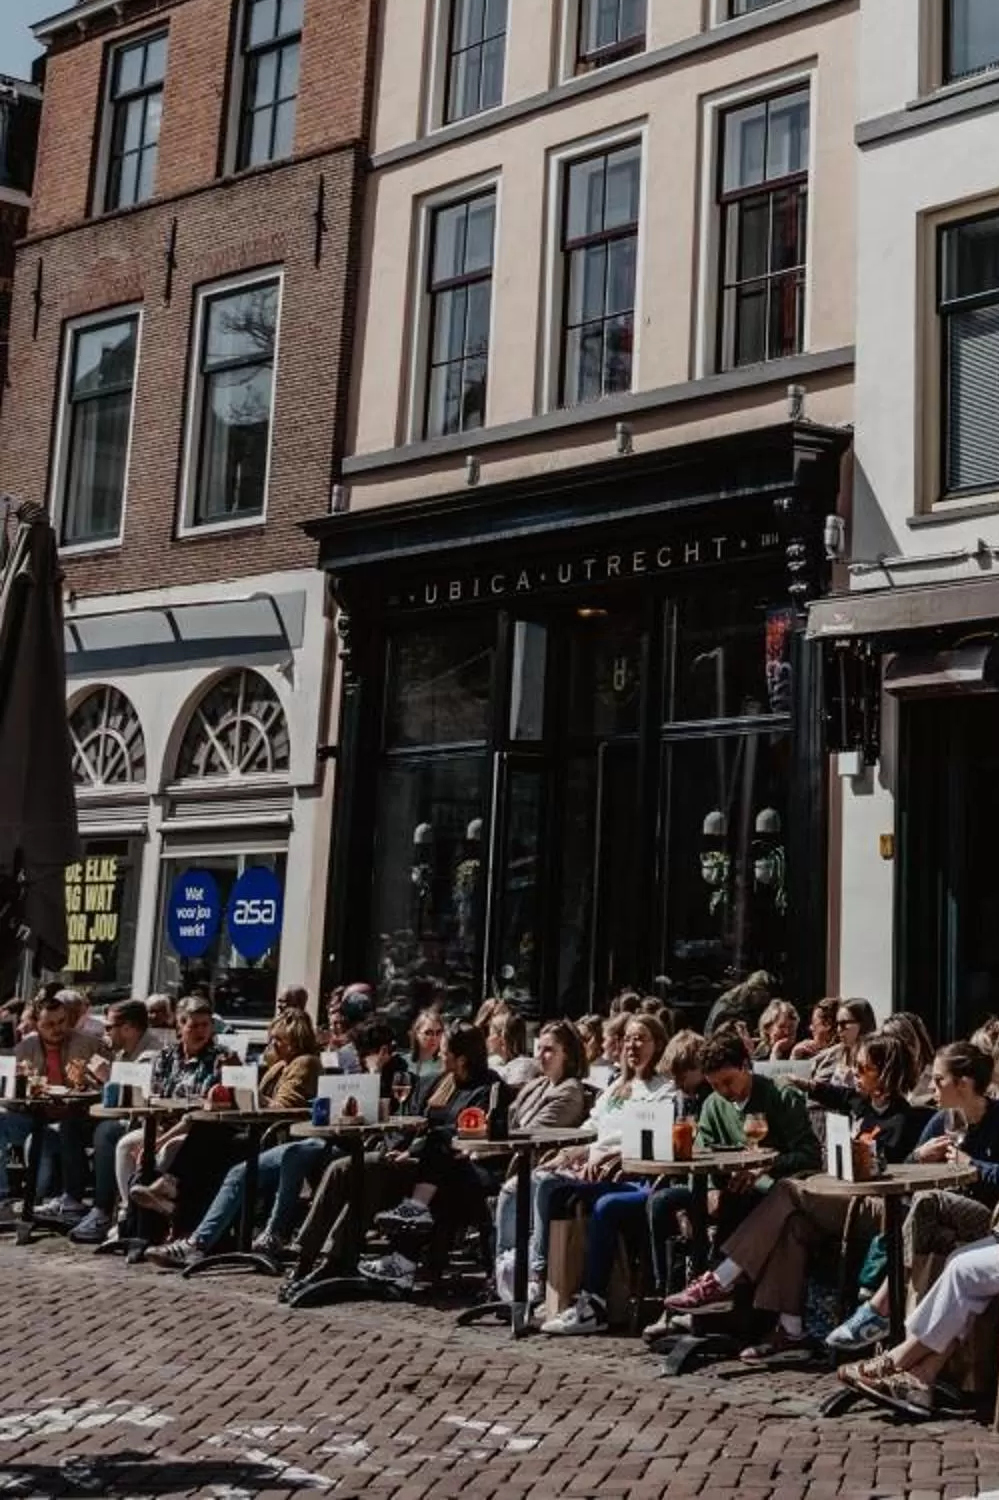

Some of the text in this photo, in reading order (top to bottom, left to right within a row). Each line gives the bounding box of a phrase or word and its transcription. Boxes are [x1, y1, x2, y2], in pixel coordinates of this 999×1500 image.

[424, 570, 532, 605] UBICA
[557, 536, 729, 584] UTRECHT
[85, 856, 118, 883] ELKE
[85, 884, 115, 912] WAT
[233, 899, 277, 925] asa
[89, 913, 118, 941] JOU
